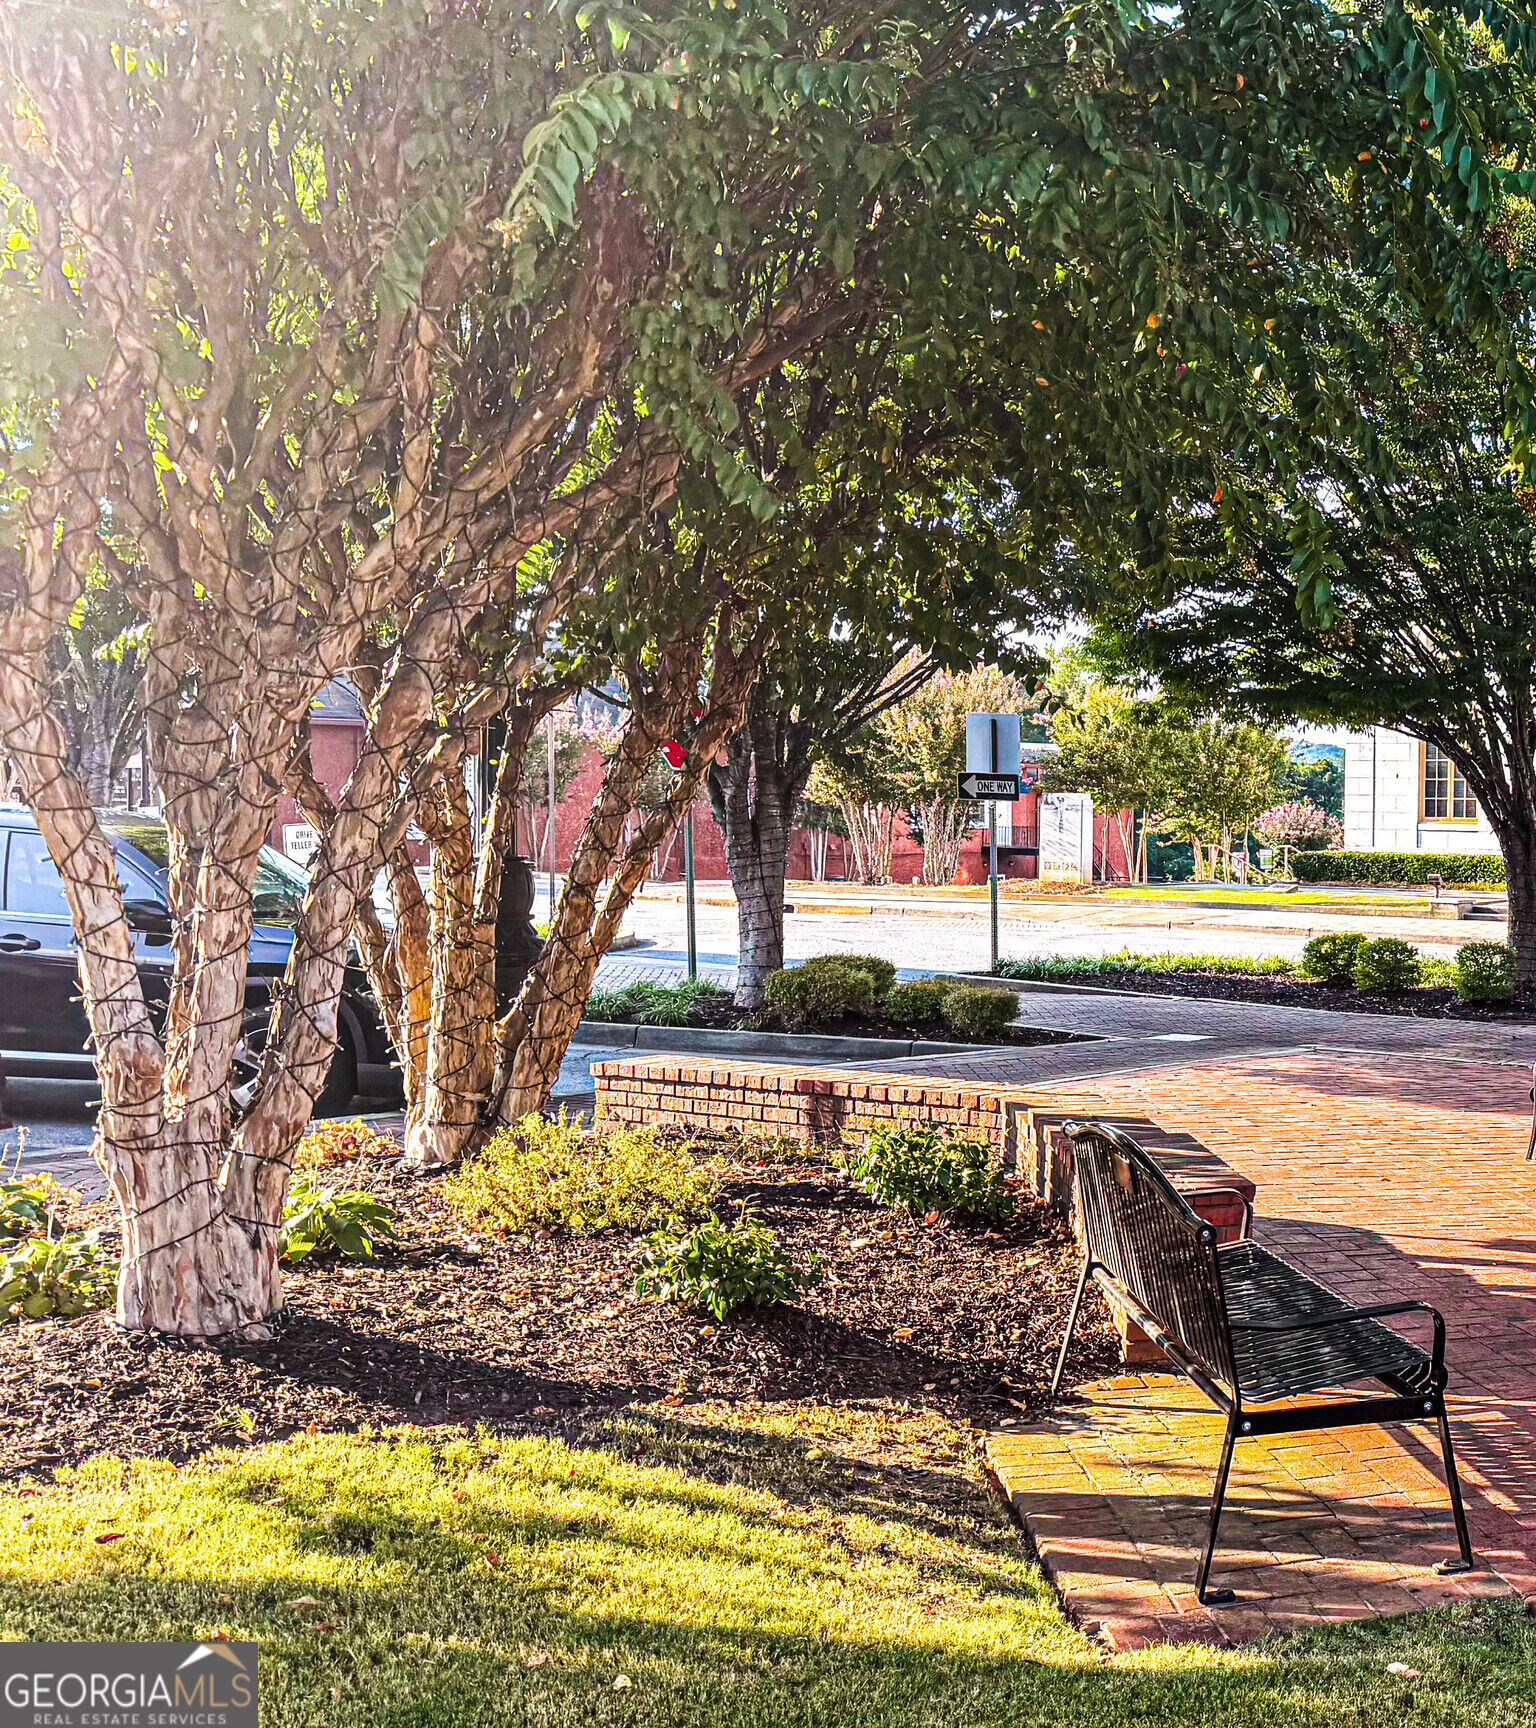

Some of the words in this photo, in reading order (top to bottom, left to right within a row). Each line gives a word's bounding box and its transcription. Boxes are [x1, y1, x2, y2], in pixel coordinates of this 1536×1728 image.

[977, 781, 995, 792] ONE
[996, 781, 1013, 793] WAY
[295, 830, 314, 839] DRIVE
[291, 841, 312, 850] TELLER
